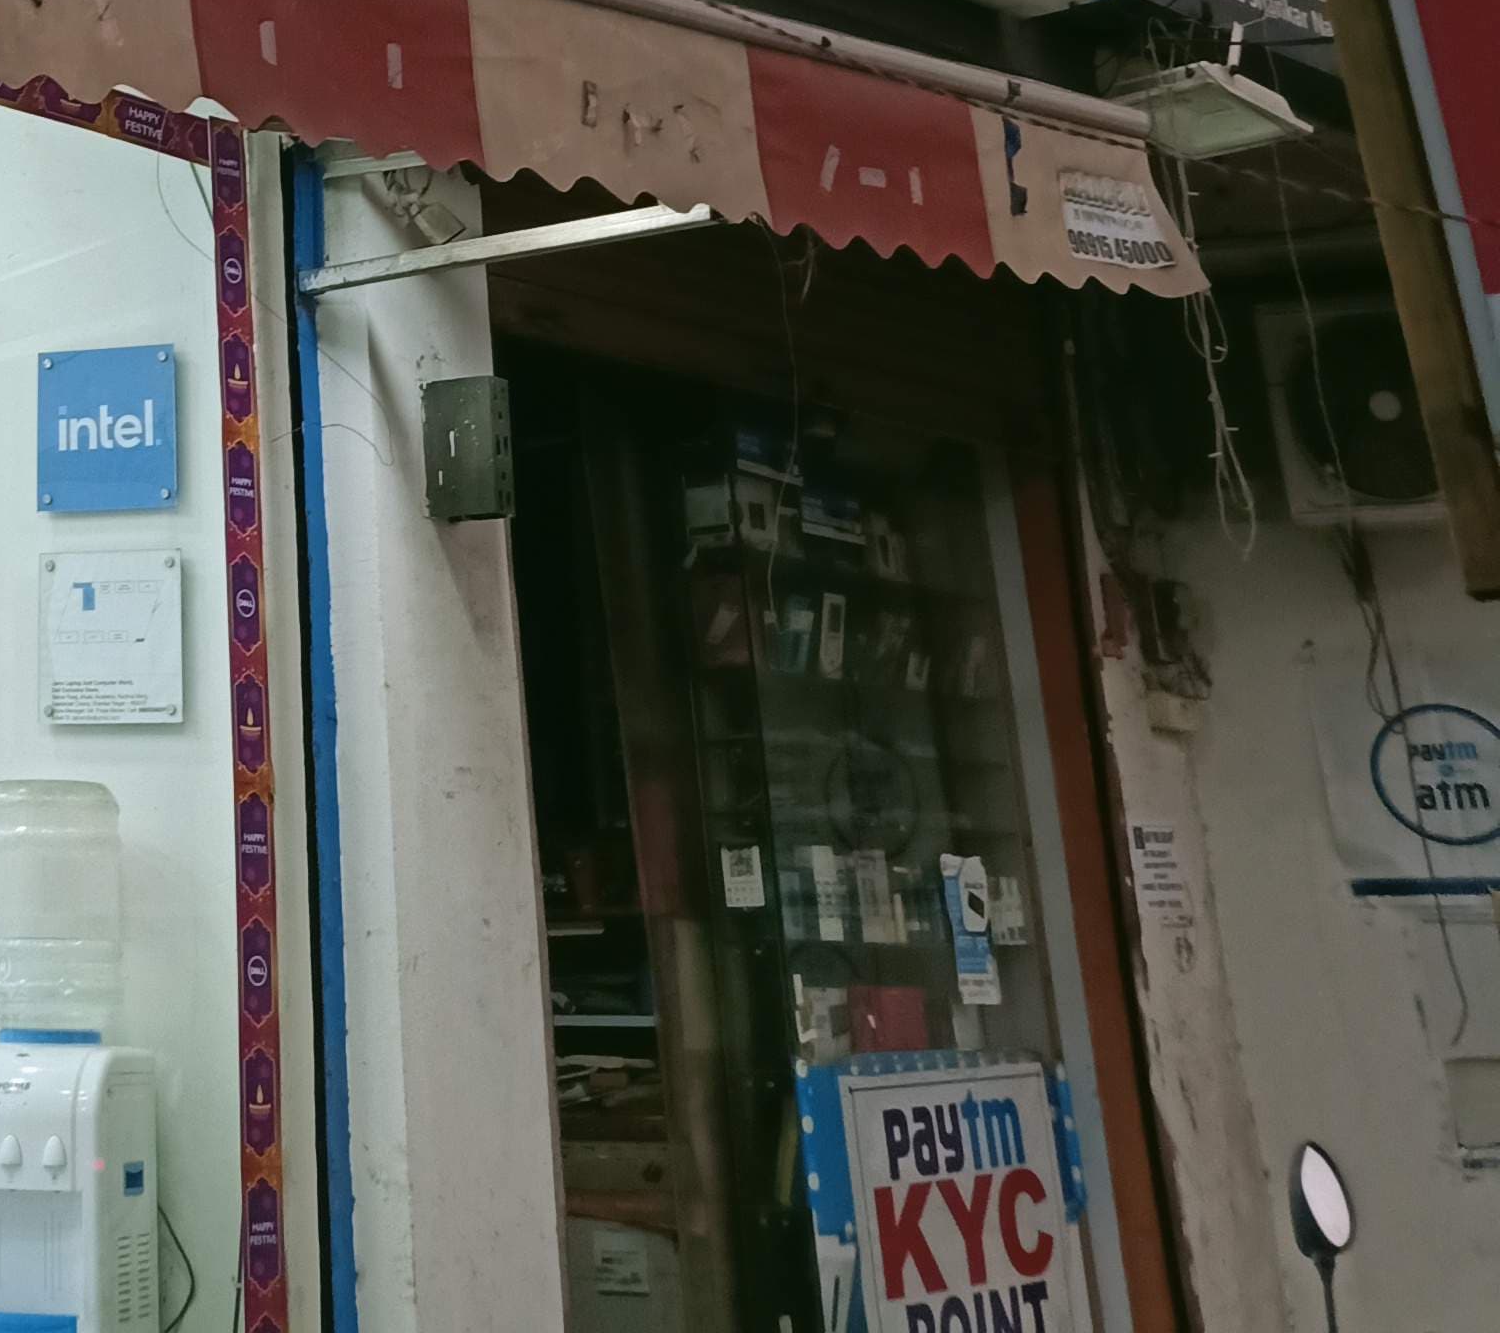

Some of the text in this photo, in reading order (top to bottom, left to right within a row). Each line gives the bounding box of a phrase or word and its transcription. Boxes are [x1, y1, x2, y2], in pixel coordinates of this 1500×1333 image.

[1417, 779, 1491, 811] atm
[883, 1089, 1026, 1180] paytm
[874, 1168, 1055, 1301] KYC
[905, 1281, 1049, 1333] POINT
